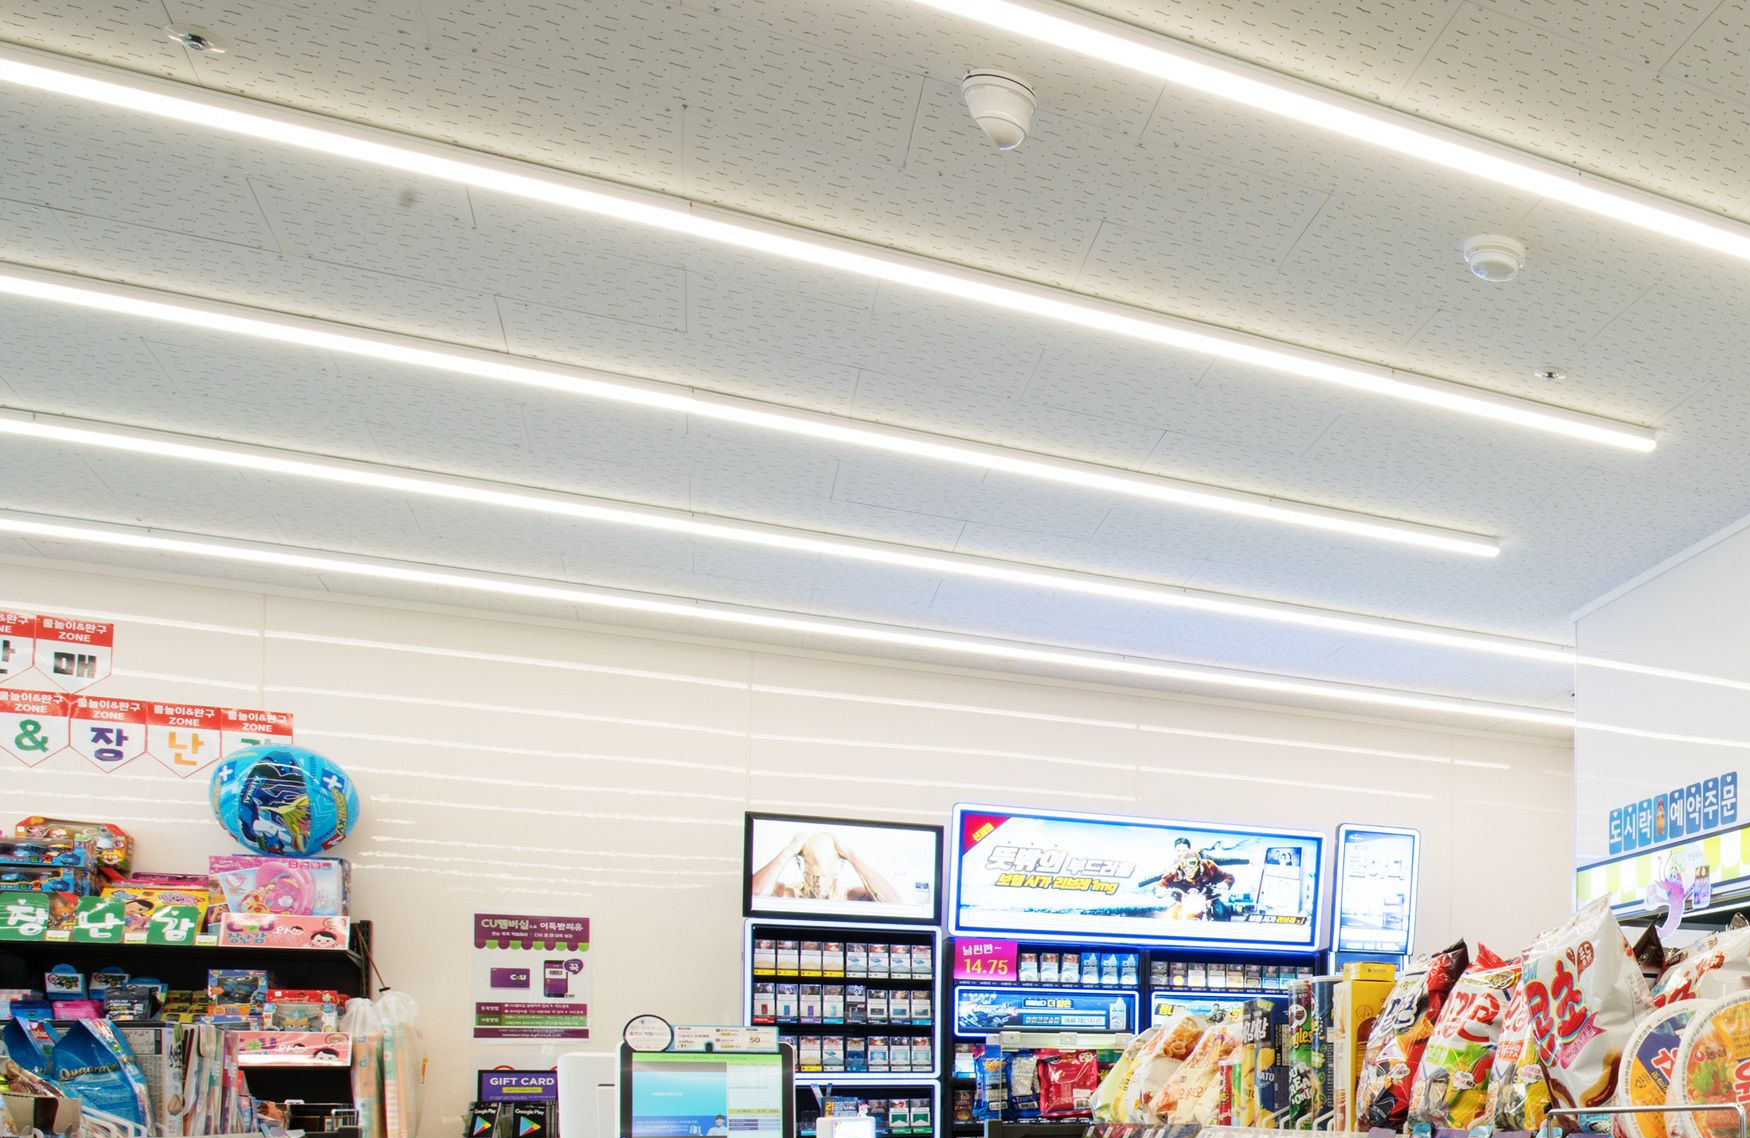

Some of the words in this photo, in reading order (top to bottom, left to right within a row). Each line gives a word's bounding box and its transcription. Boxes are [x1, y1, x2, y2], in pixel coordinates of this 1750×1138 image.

[58, 632, 90, 642] ZONE
[53, 652, 97, 678] 매
[14, 703, 48, 713] ZONE
[92, 710, 124, 720] ZONE
[169, 717, 200, 726] ZONE
[242, 722, 272, 732] ZONE
[168, 732, 204, 766] 난
[1610, 815, 1652, 845] 도시락
[984, 845, 1068, 873] 뜻밖의
[964, 959, 1008, 974] 14.75
[490, 1078, 518, 1086] GIFT
[520, 1077, 555, 1086] CARD
[533, 1109, 545, 1117] Play
